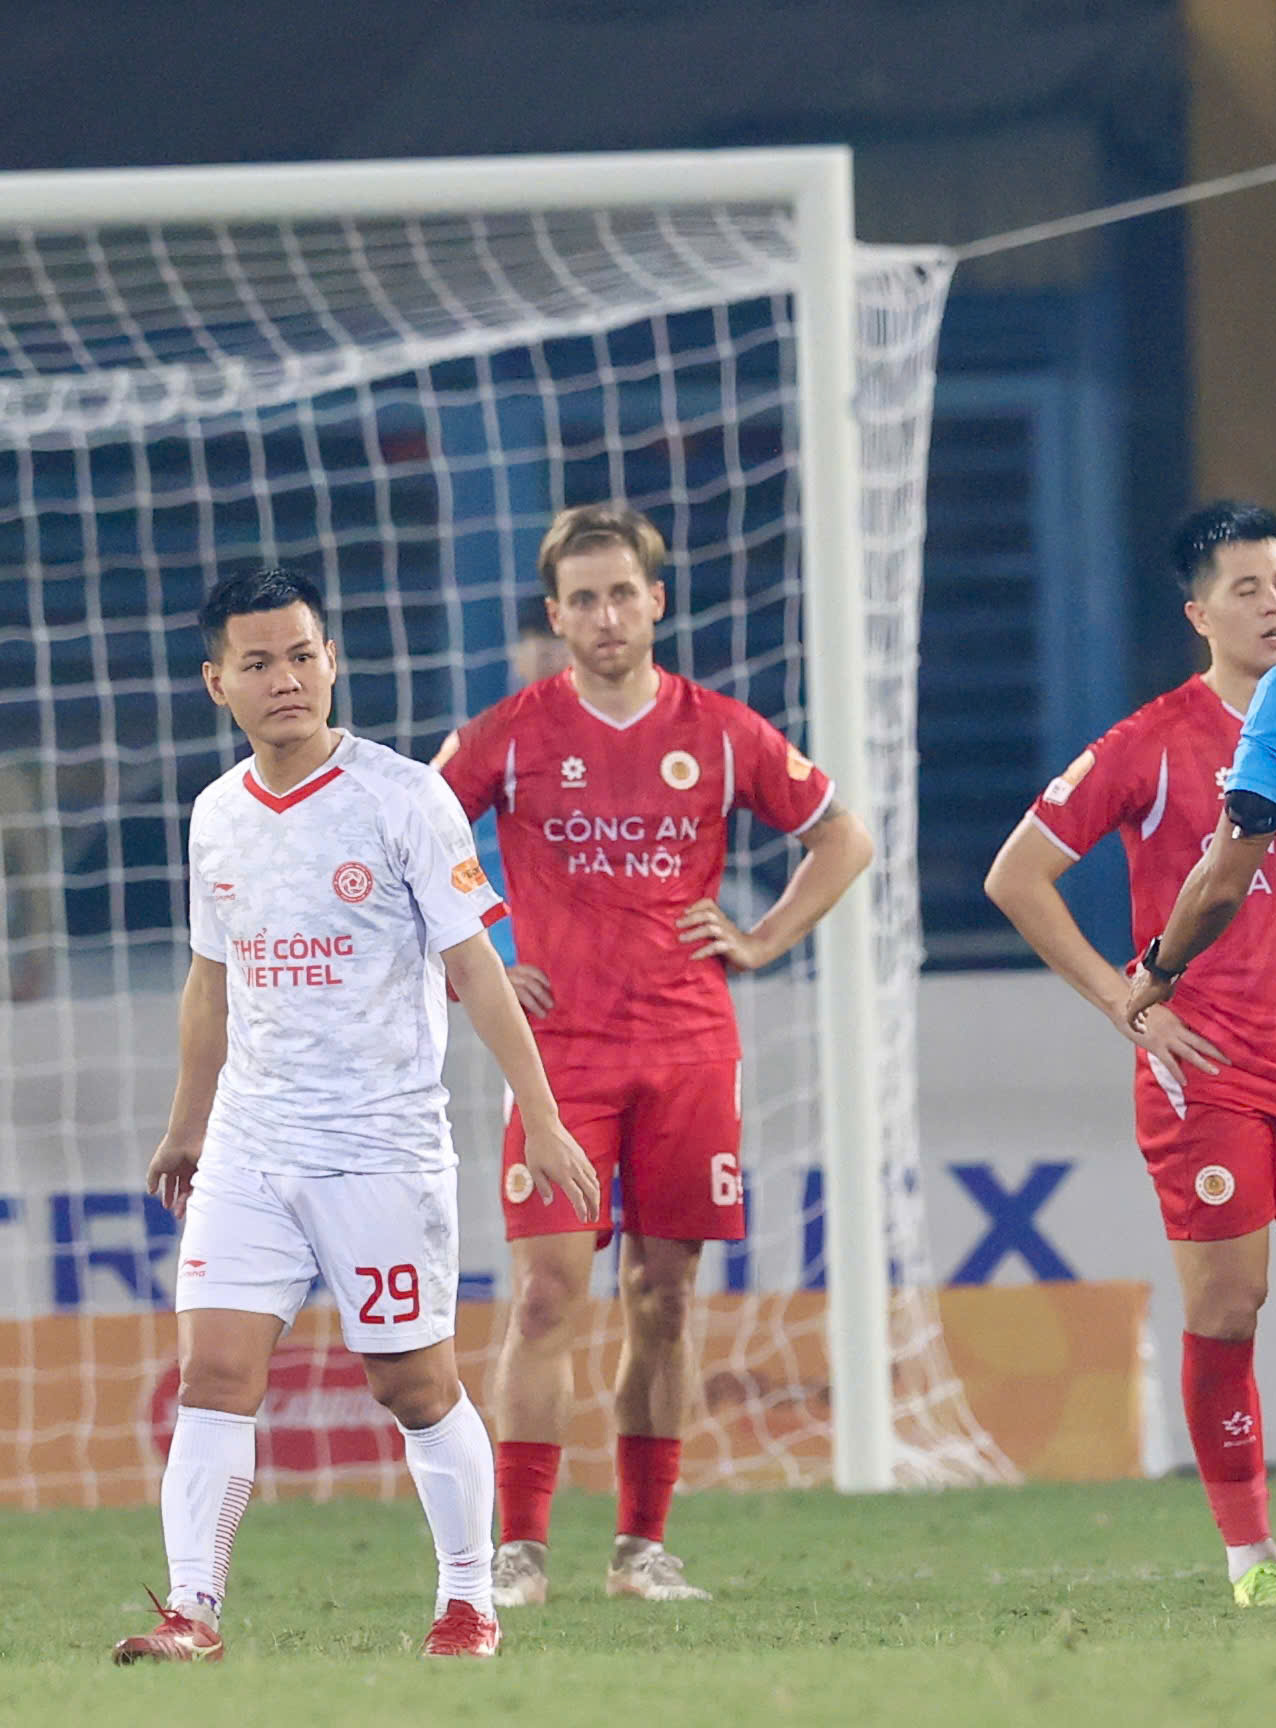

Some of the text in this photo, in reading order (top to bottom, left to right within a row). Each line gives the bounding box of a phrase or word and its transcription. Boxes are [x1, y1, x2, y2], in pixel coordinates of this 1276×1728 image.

[543, 809, 700, 842] CÔNG AN
[568, 845, 682, 883] HÀ NỘI
[232, 927, 354, 961] THỂ CÔNG
[241, 964, 343, 988] VIETTEL
[355, 1263, 420, 1325] 29
